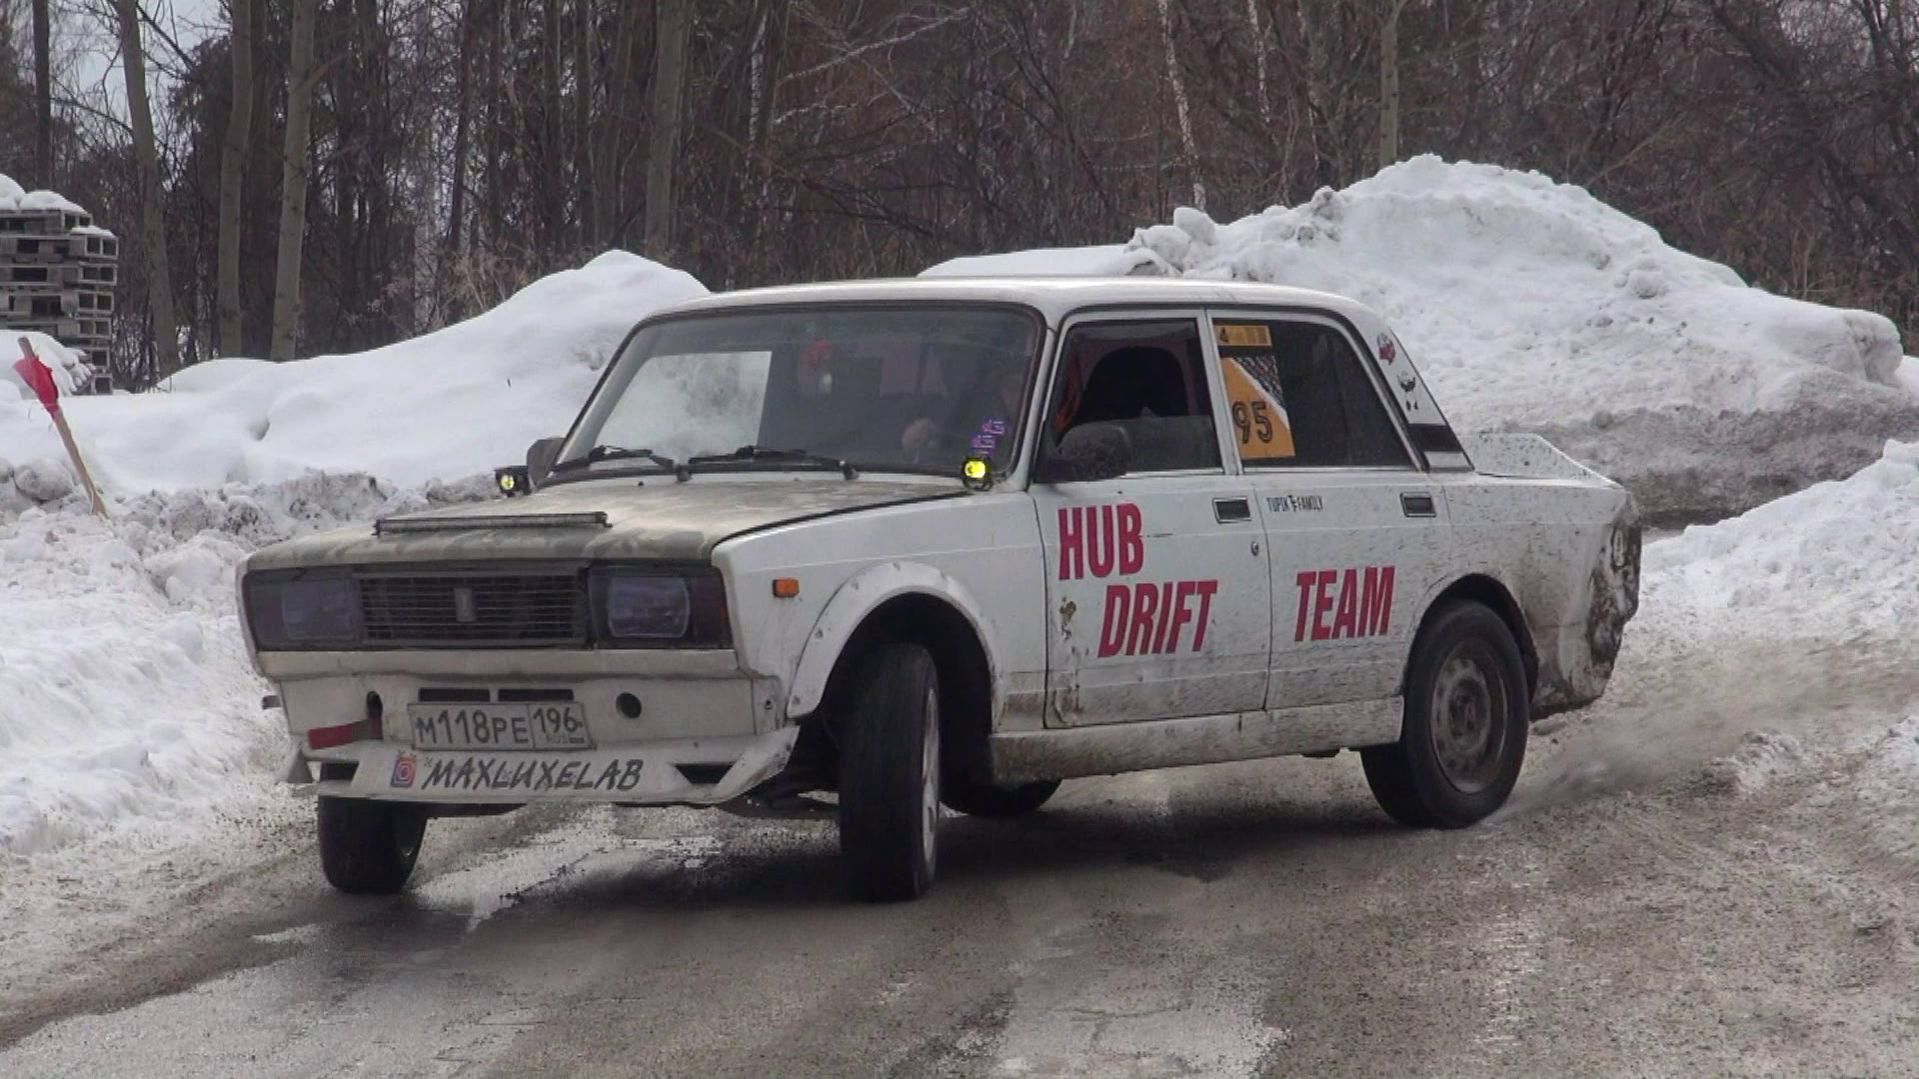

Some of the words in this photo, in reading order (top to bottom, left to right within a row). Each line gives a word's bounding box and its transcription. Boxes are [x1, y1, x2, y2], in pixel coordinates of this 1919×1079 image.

[1232, 401, 1273, 444] 95
[1057, 503, 1145, 580] HUB
[1097, 580, 1218, 657] DRIFT
[1294, 566, 1395, 641] TEAM
[533, 707, 578, 734] 196
[421, 757, 644, 790] MAXLUXELAB
